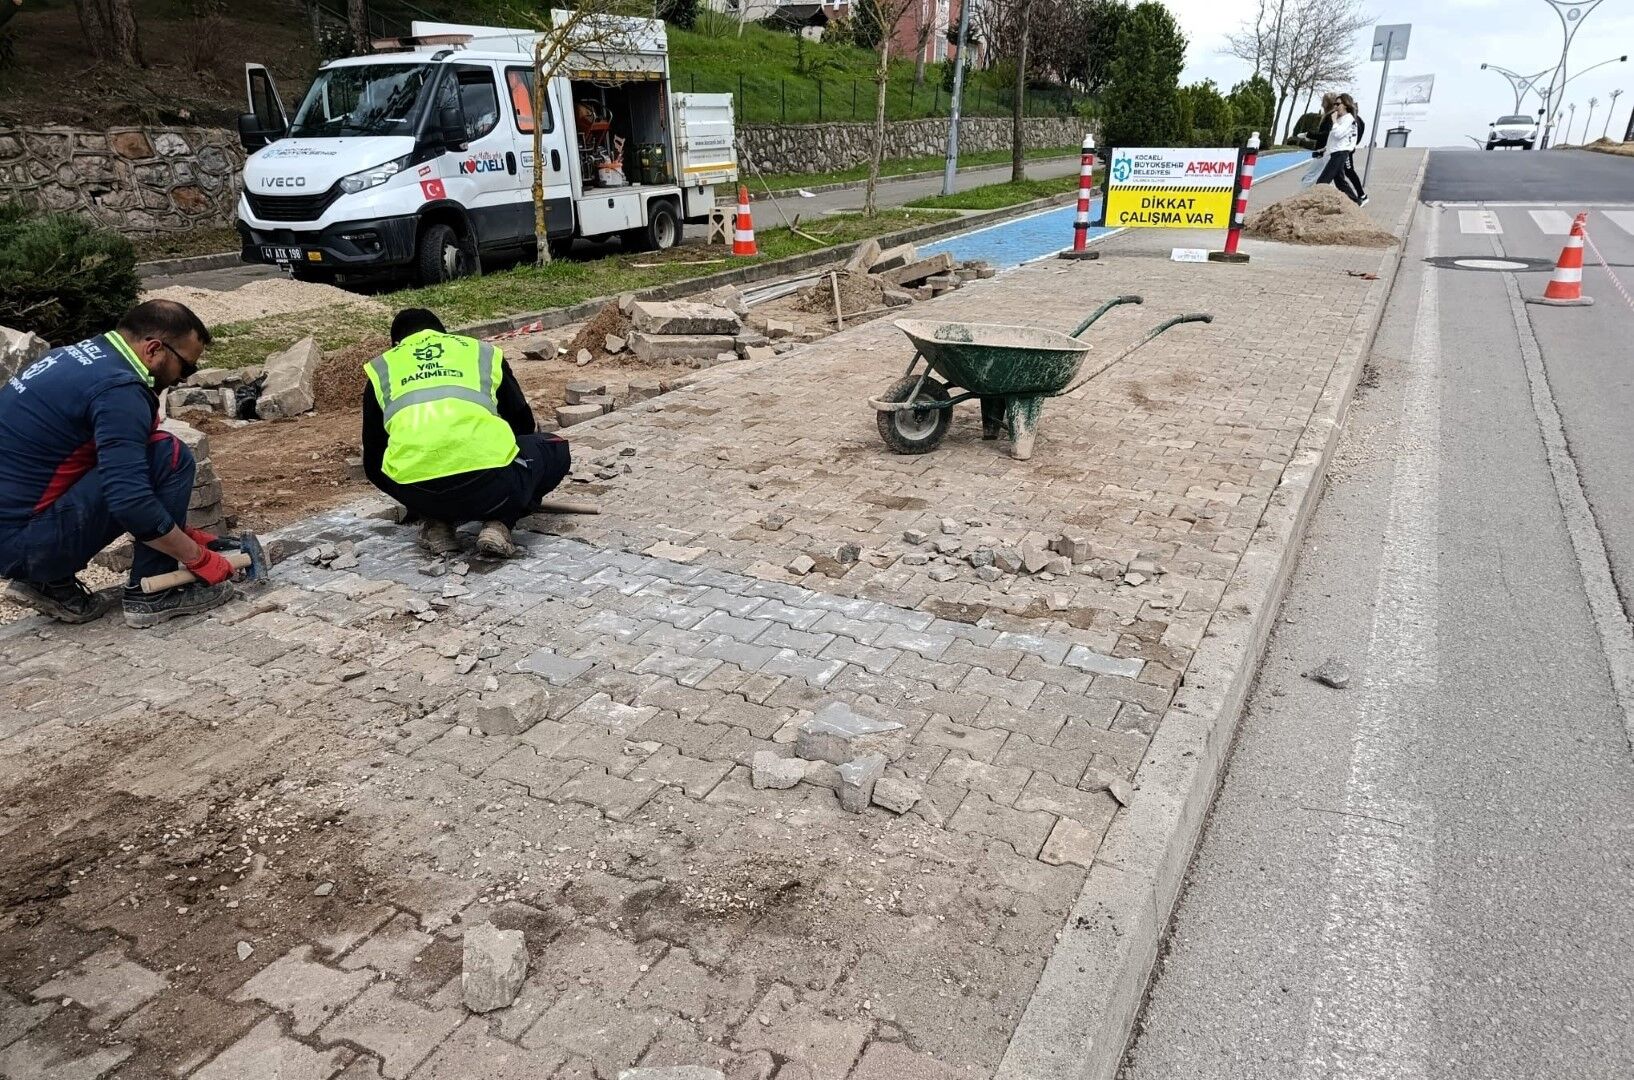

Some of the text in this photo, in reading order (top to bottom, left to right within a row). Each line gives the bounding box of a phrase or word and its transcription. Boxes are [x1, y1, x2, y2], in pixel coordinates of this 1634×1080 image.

[1134, 161, 1184, 169] BÜYÜKŞEHİR
[1185, 162, 1235, 174] A-TAKIMI
[261, 176, 306, 187] IVECO
[1141, 195, 1196, 210] DİKKAT
[1119, 211, 1214, 225] ÇALIŞMA VAR
